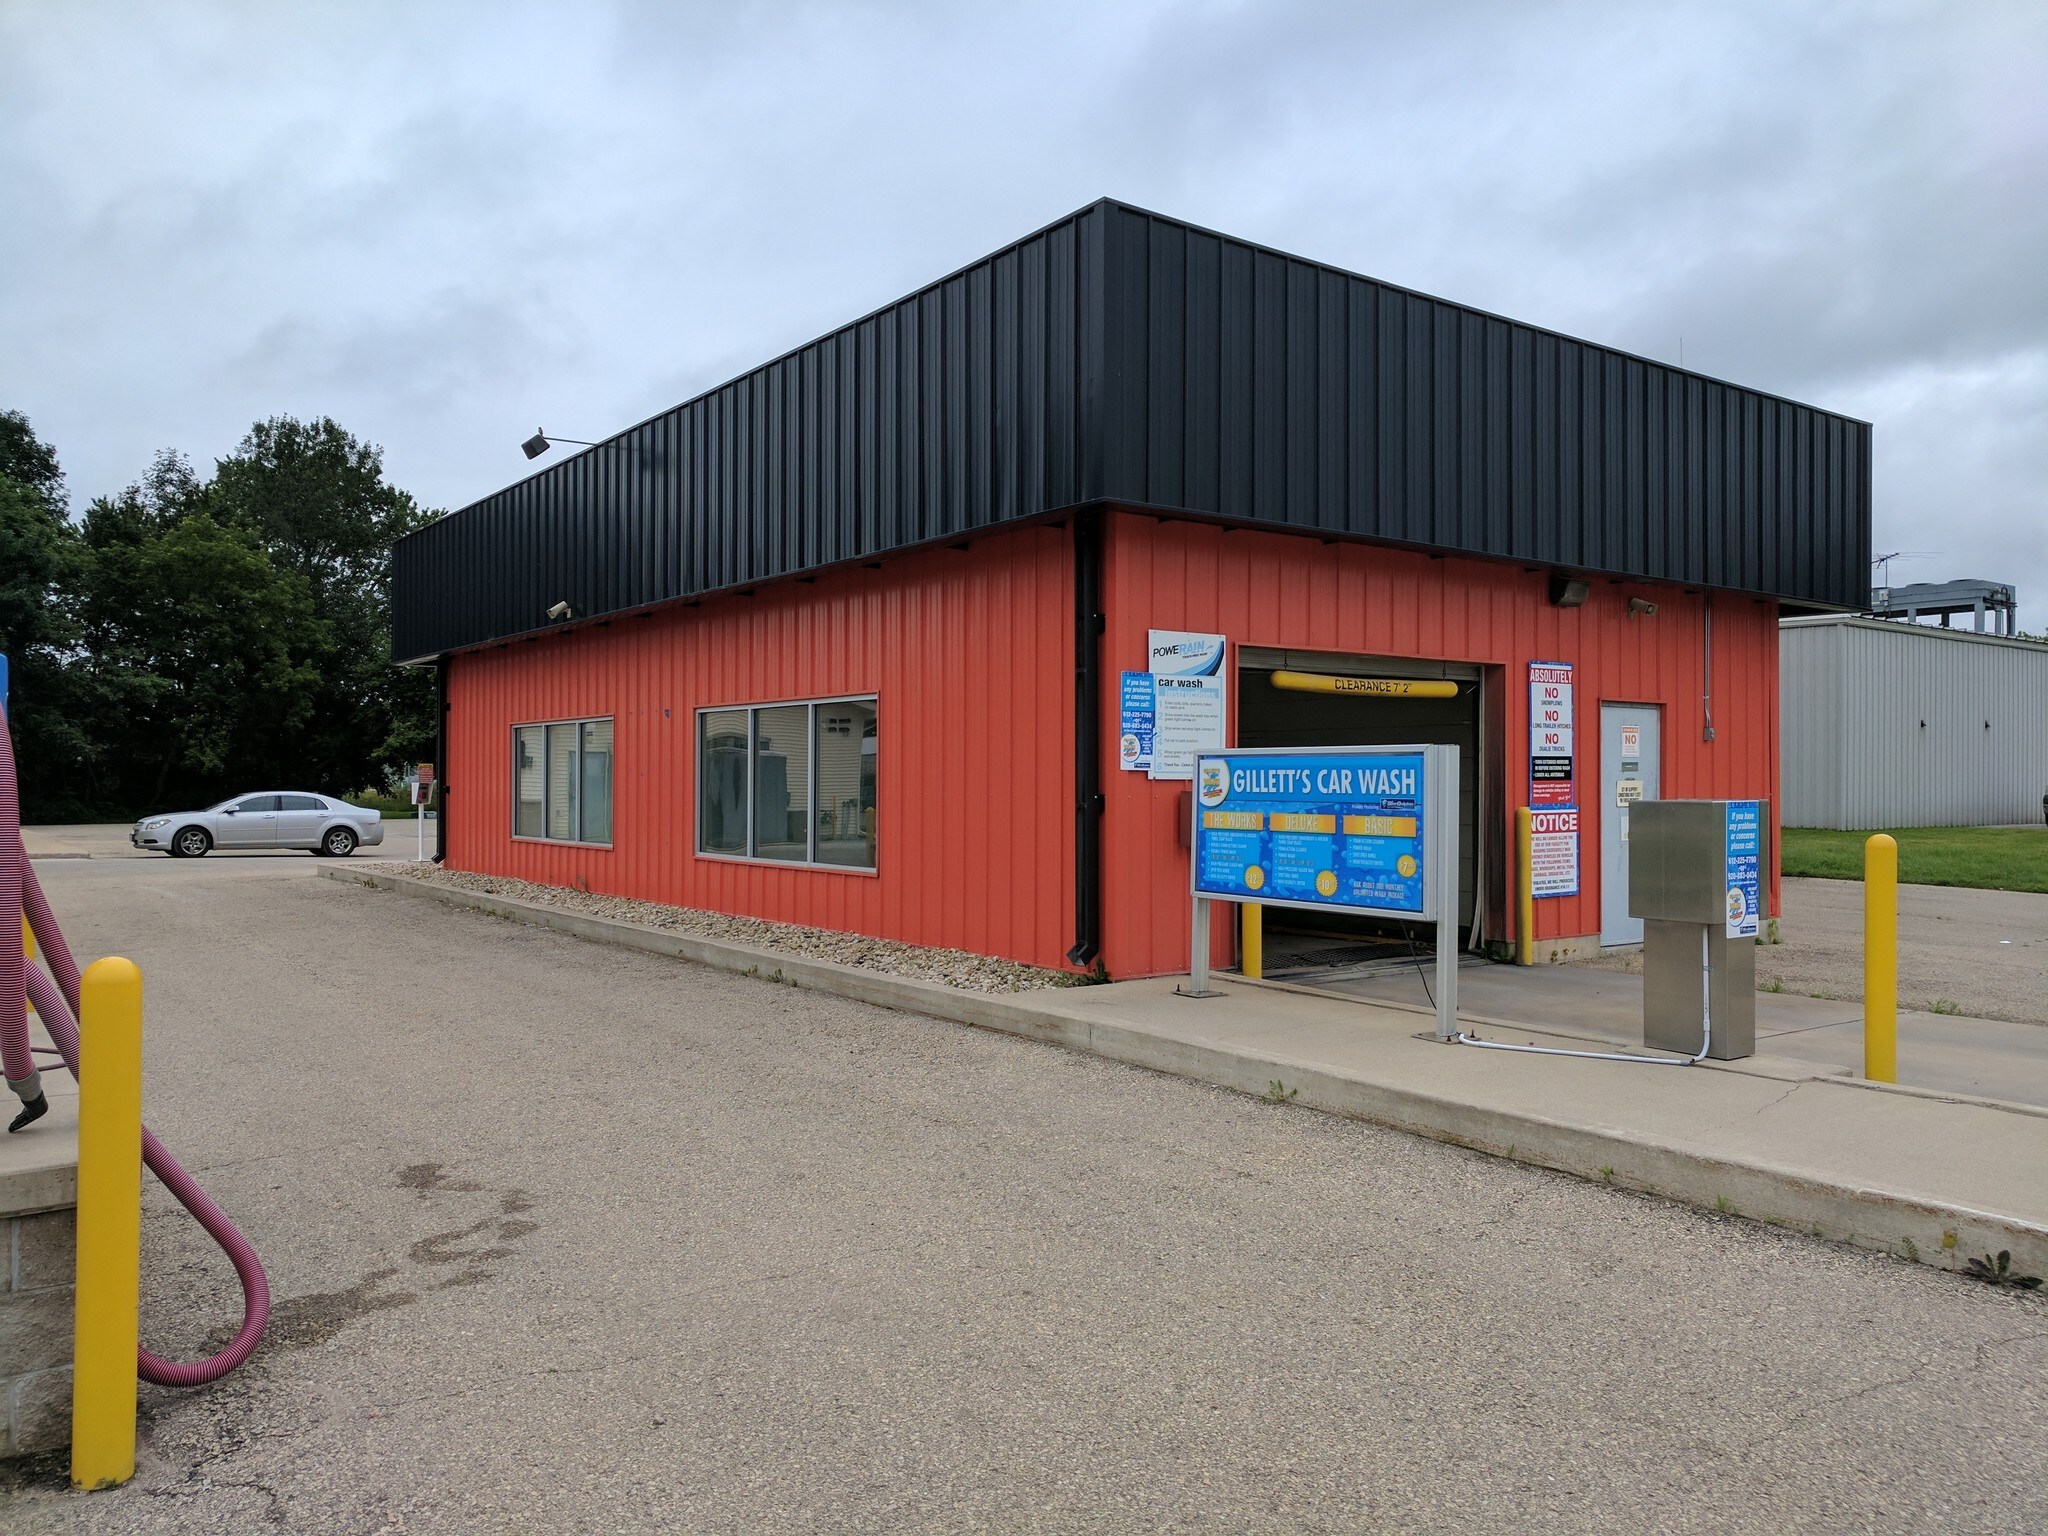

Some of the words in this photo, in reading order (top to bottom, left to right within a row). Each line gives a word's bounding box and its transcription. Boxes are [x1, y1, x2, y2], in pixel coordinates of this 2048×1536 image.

[1530, 669, 1572, 683] ABSOLUTELY
[1178, 679, 1203, 688] wash
[1335, 679, 1391, 692] CLEARANCE
[1545, 688, 1558, 698] NO
[1545, 711, 1559, 721] NO
[1545, 734, 1559, 744] NO
[1625, 735, 1636, 744] NO
[1233, 769, 1310, 794] GILLETT'S
[1317, 769, 1352, 794] CAR
[1358, 769, 1415, 795] WASH
[1210, 813, 1223, 827] THE
[1228, 814, 1257, 829] WORKS
[1745, 812, 1754, 820] have
[1285, 815, 1318, 830] DELUXE
[1365, 818, 1392, 834] BASIC
[1531, 814, 1577, 831] NOTICE
[1729, 823, 1737, 831] any
[1737, 822, 1756, 830] problems
[1731, 843, 1744, 851] please
